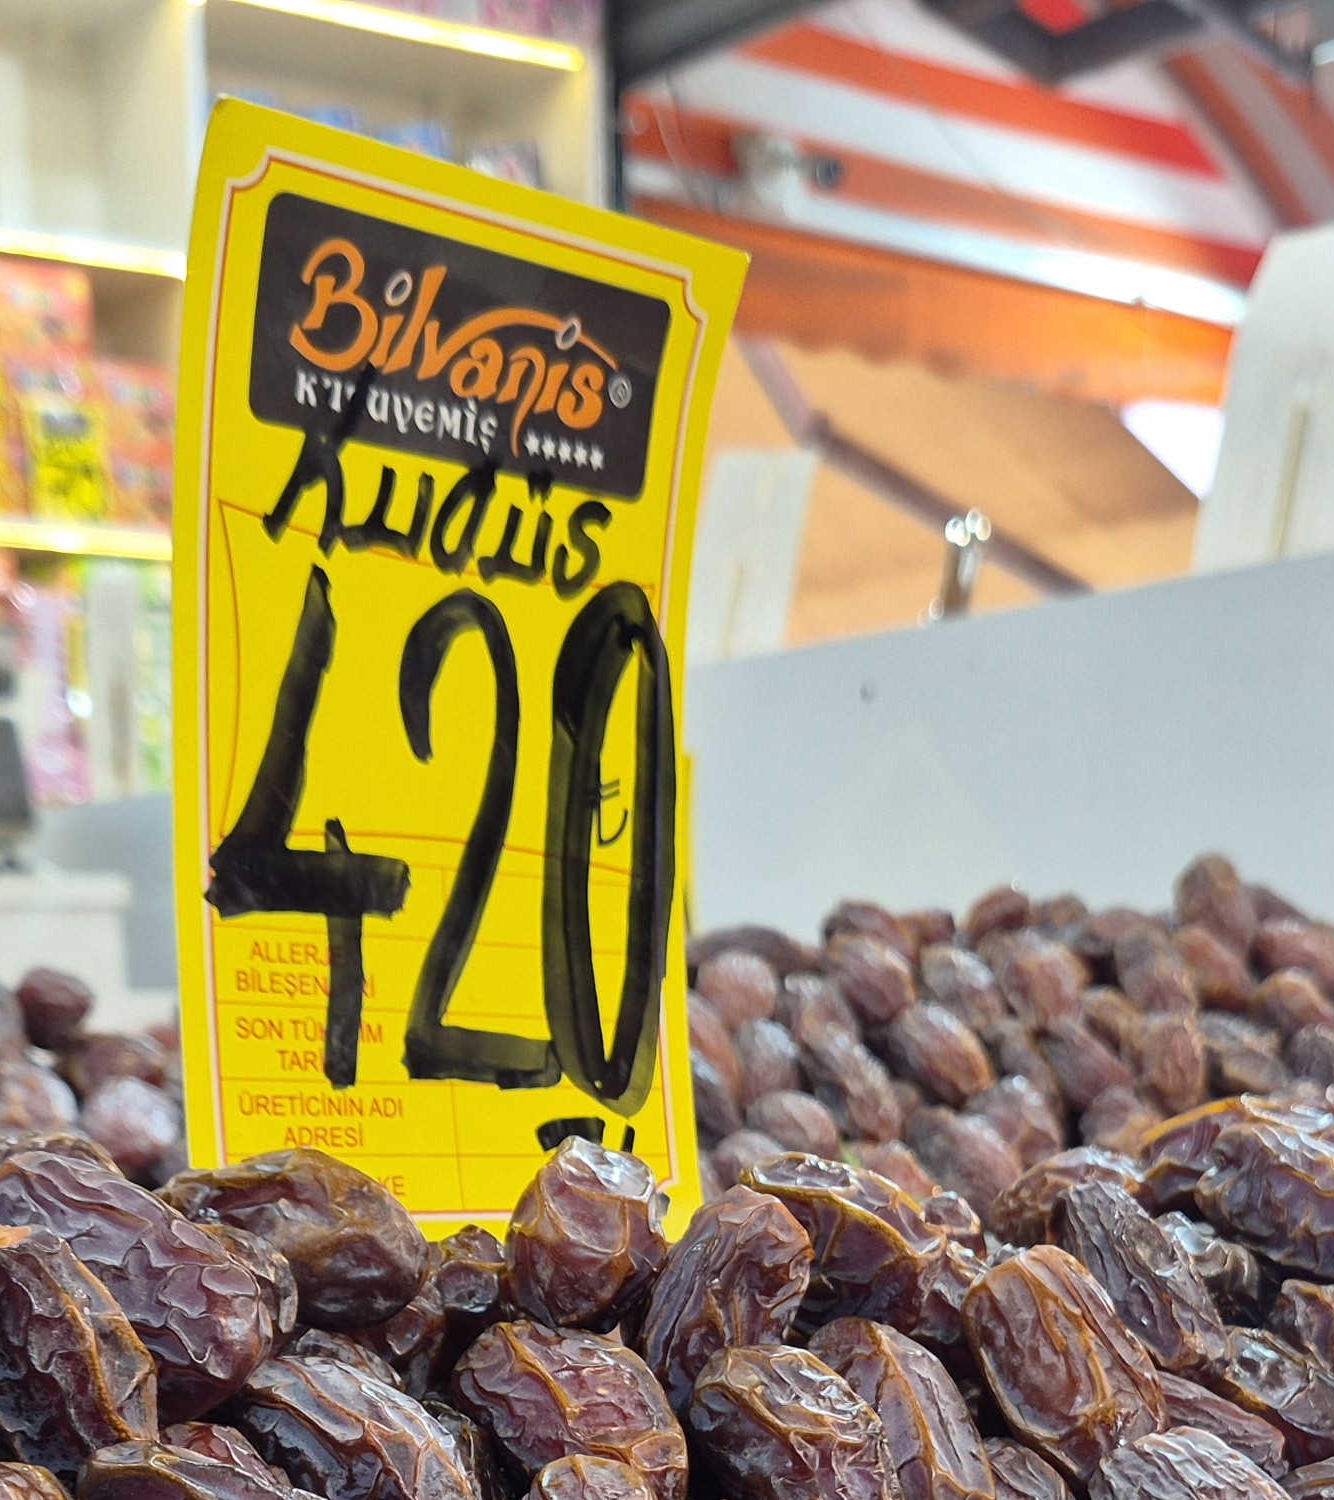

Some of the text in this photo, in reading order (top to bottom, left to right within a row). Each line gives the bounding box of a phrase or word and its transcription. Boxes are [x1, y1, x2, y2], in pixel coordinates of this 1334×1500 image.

[204, 563, 675, 1118] 420
[235, 1016, 284, 1040] SON
[238, 1088, 404, 1118] ÜRETİCİNİN ADI
[284, 1123, 364, 1148] ADRESİ
